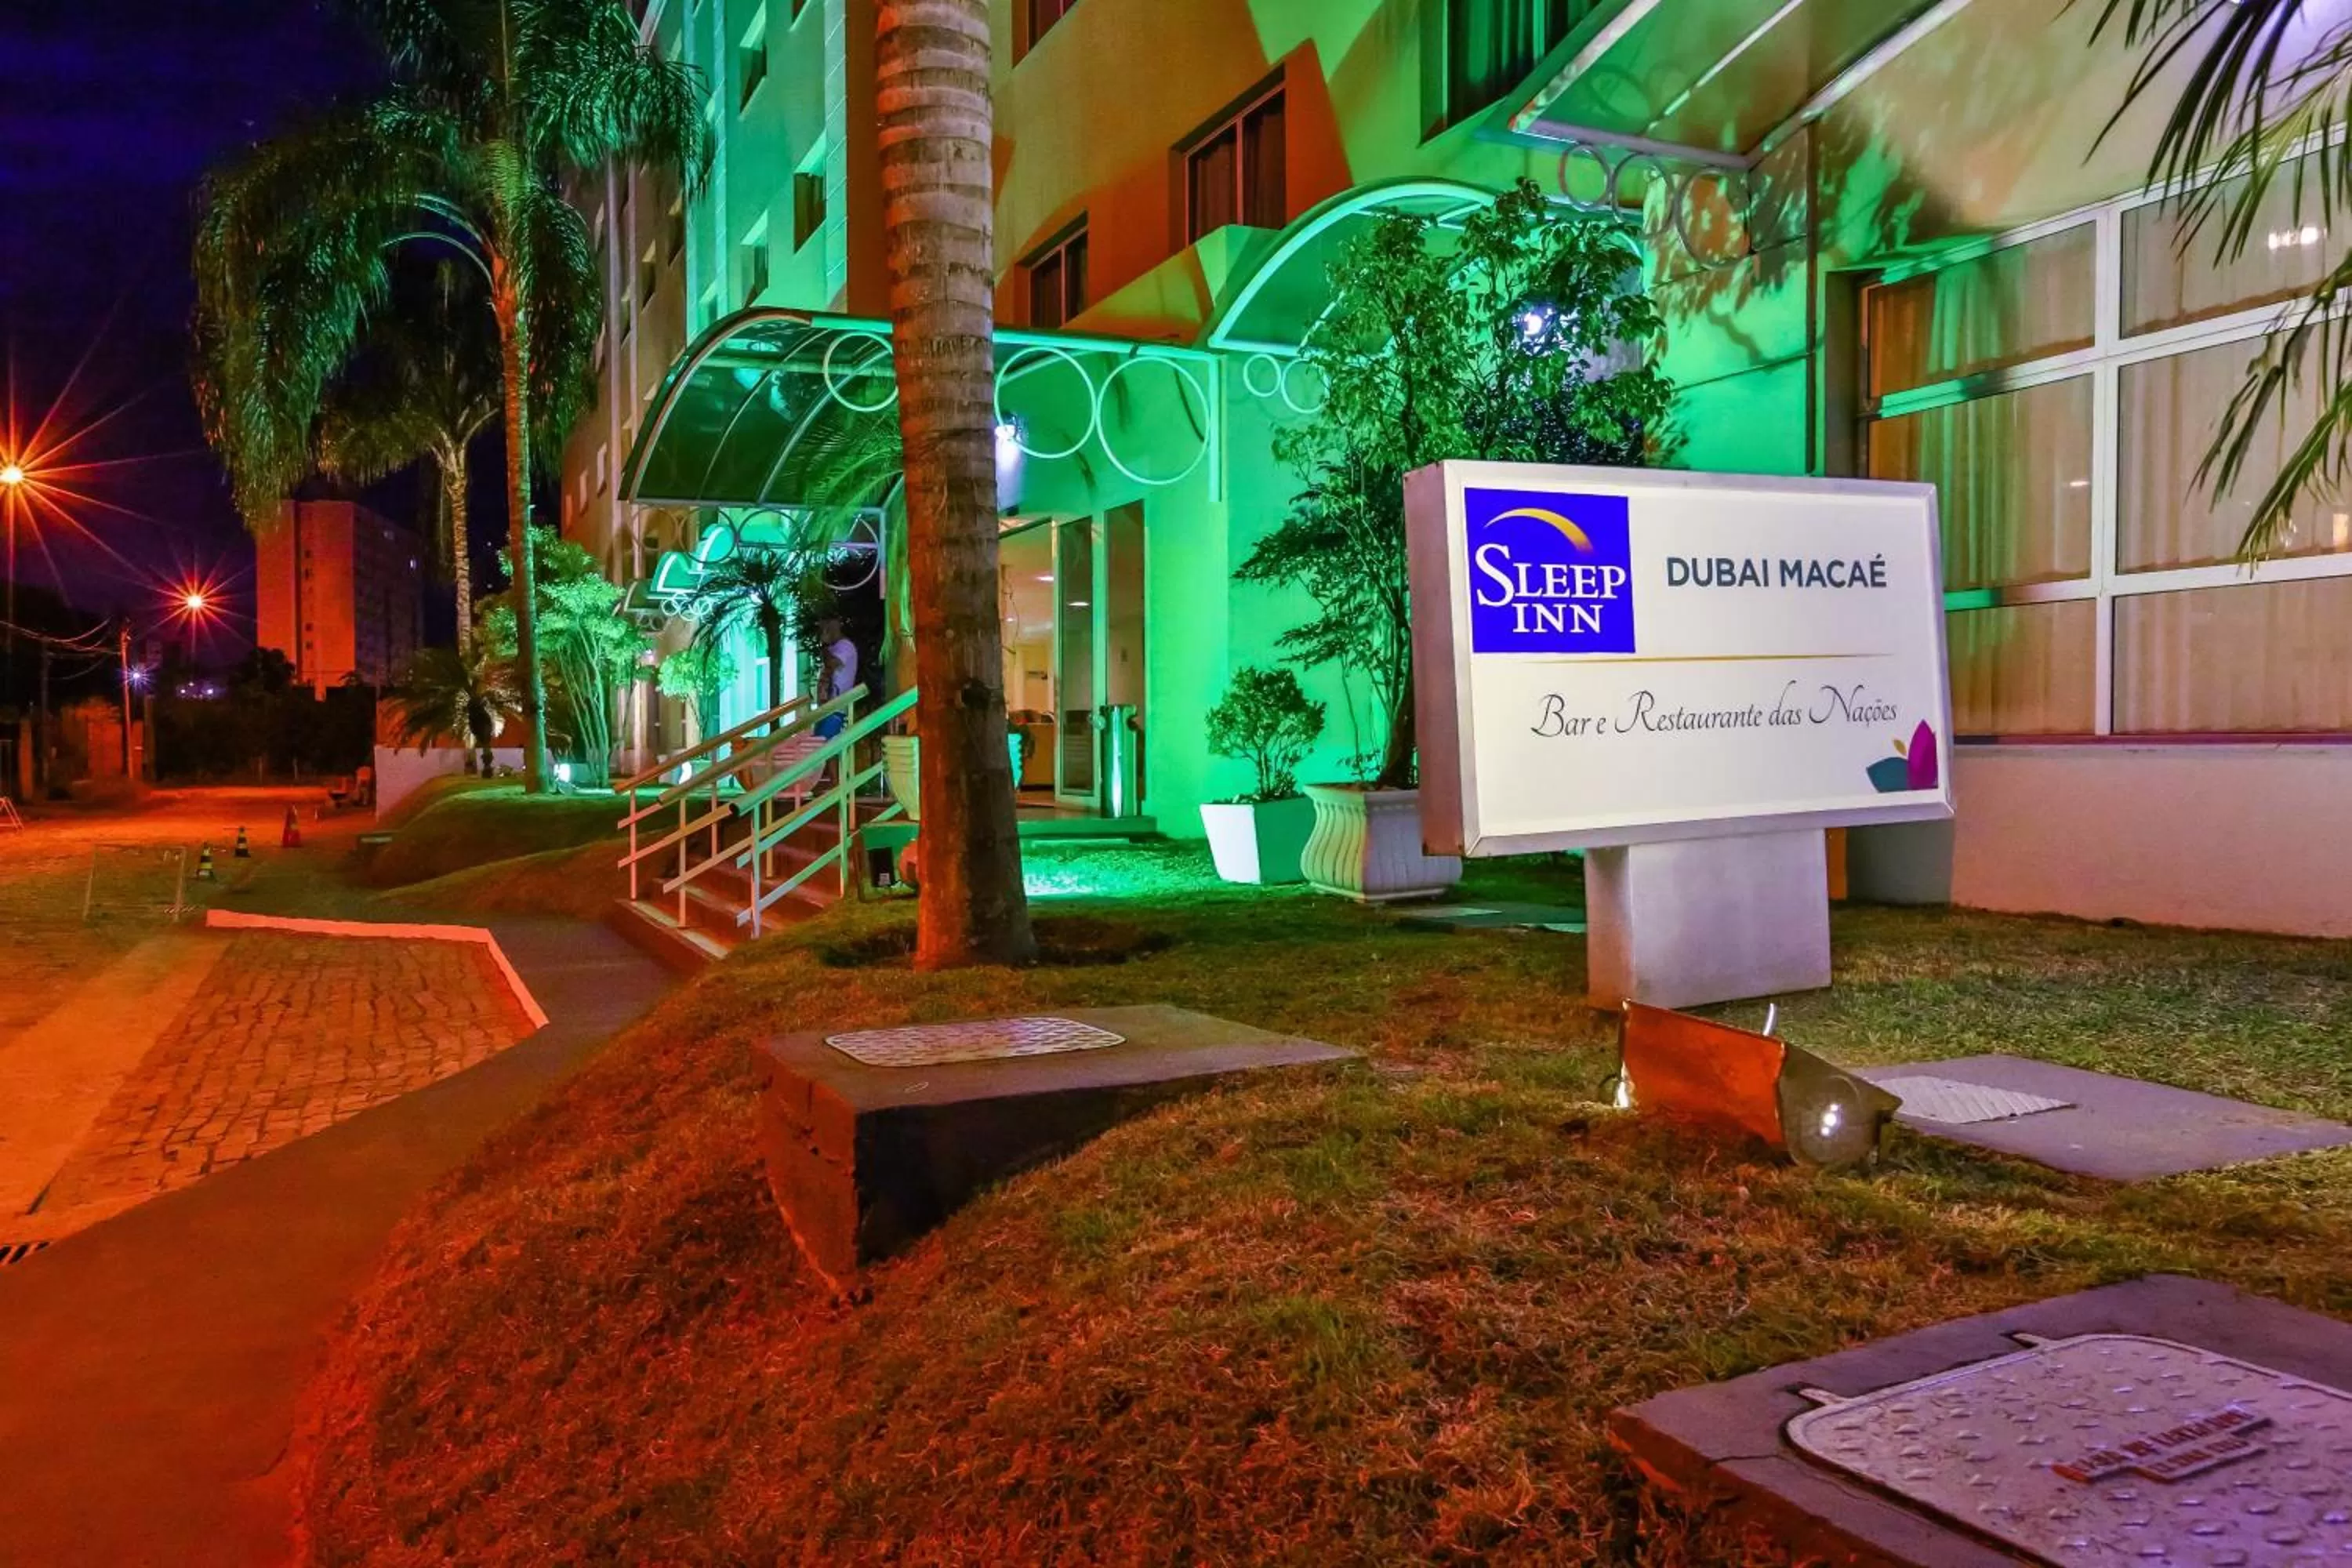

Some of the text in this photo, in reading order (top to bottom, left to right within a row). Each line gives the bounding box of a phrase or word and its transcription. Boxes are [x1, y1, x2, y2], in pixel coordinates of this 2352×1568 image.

[1475, 543, 1627, 607] SLEEP
[1666, 554, 1888, 588] DUBAI MACAÉ
[1512, 603, 1604, 633] INN
[1530, 679, 1897, 738] Bar e Restaurante das Nações
